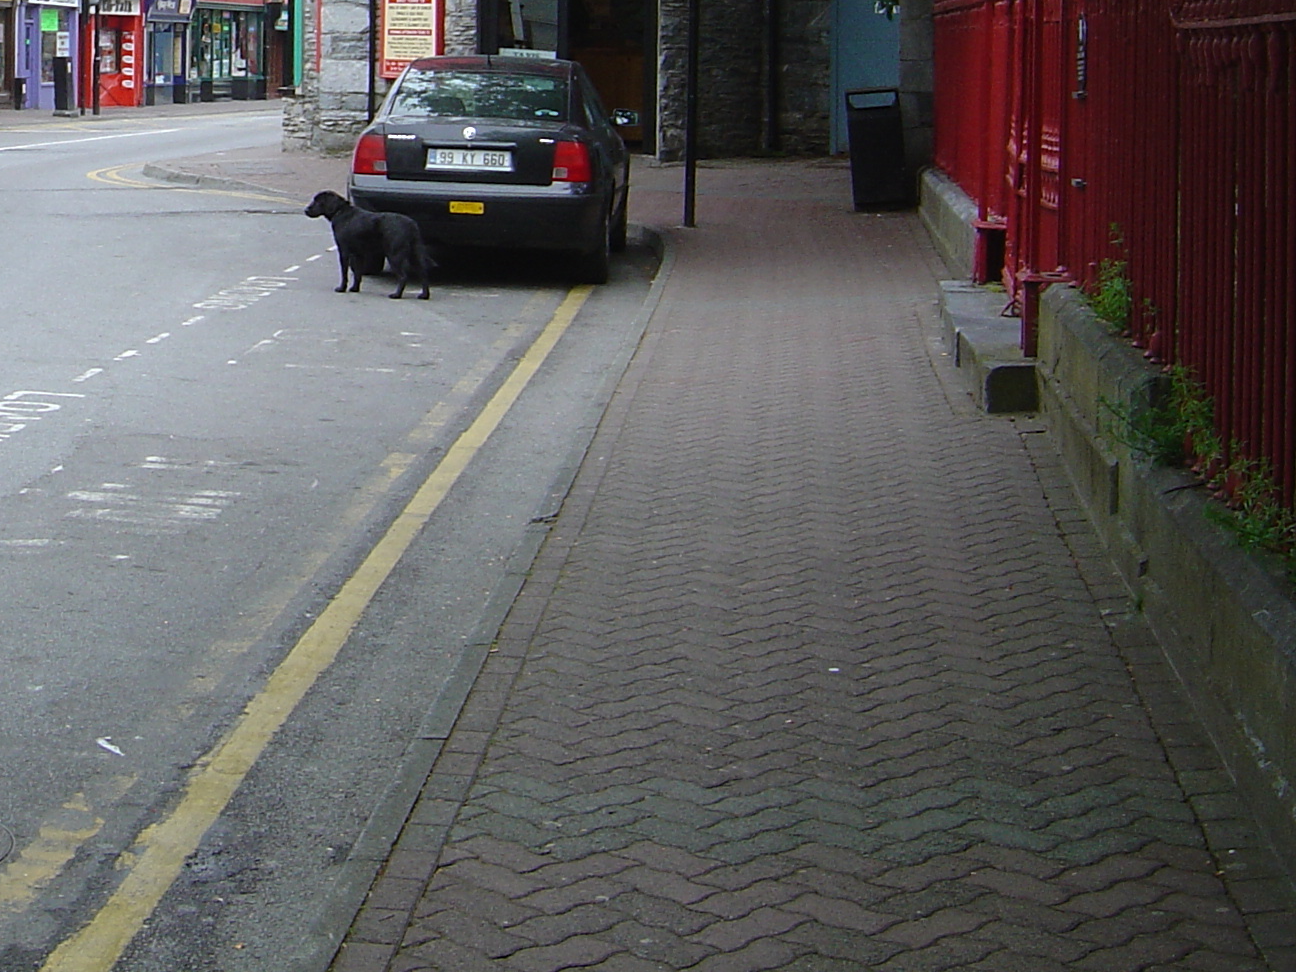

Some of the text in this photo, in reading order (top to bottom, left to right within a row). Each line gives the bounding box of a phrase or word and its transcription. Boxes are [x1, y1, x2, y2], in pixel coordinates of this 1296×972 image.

[439, 151, 505, 166] 99 KY 660
